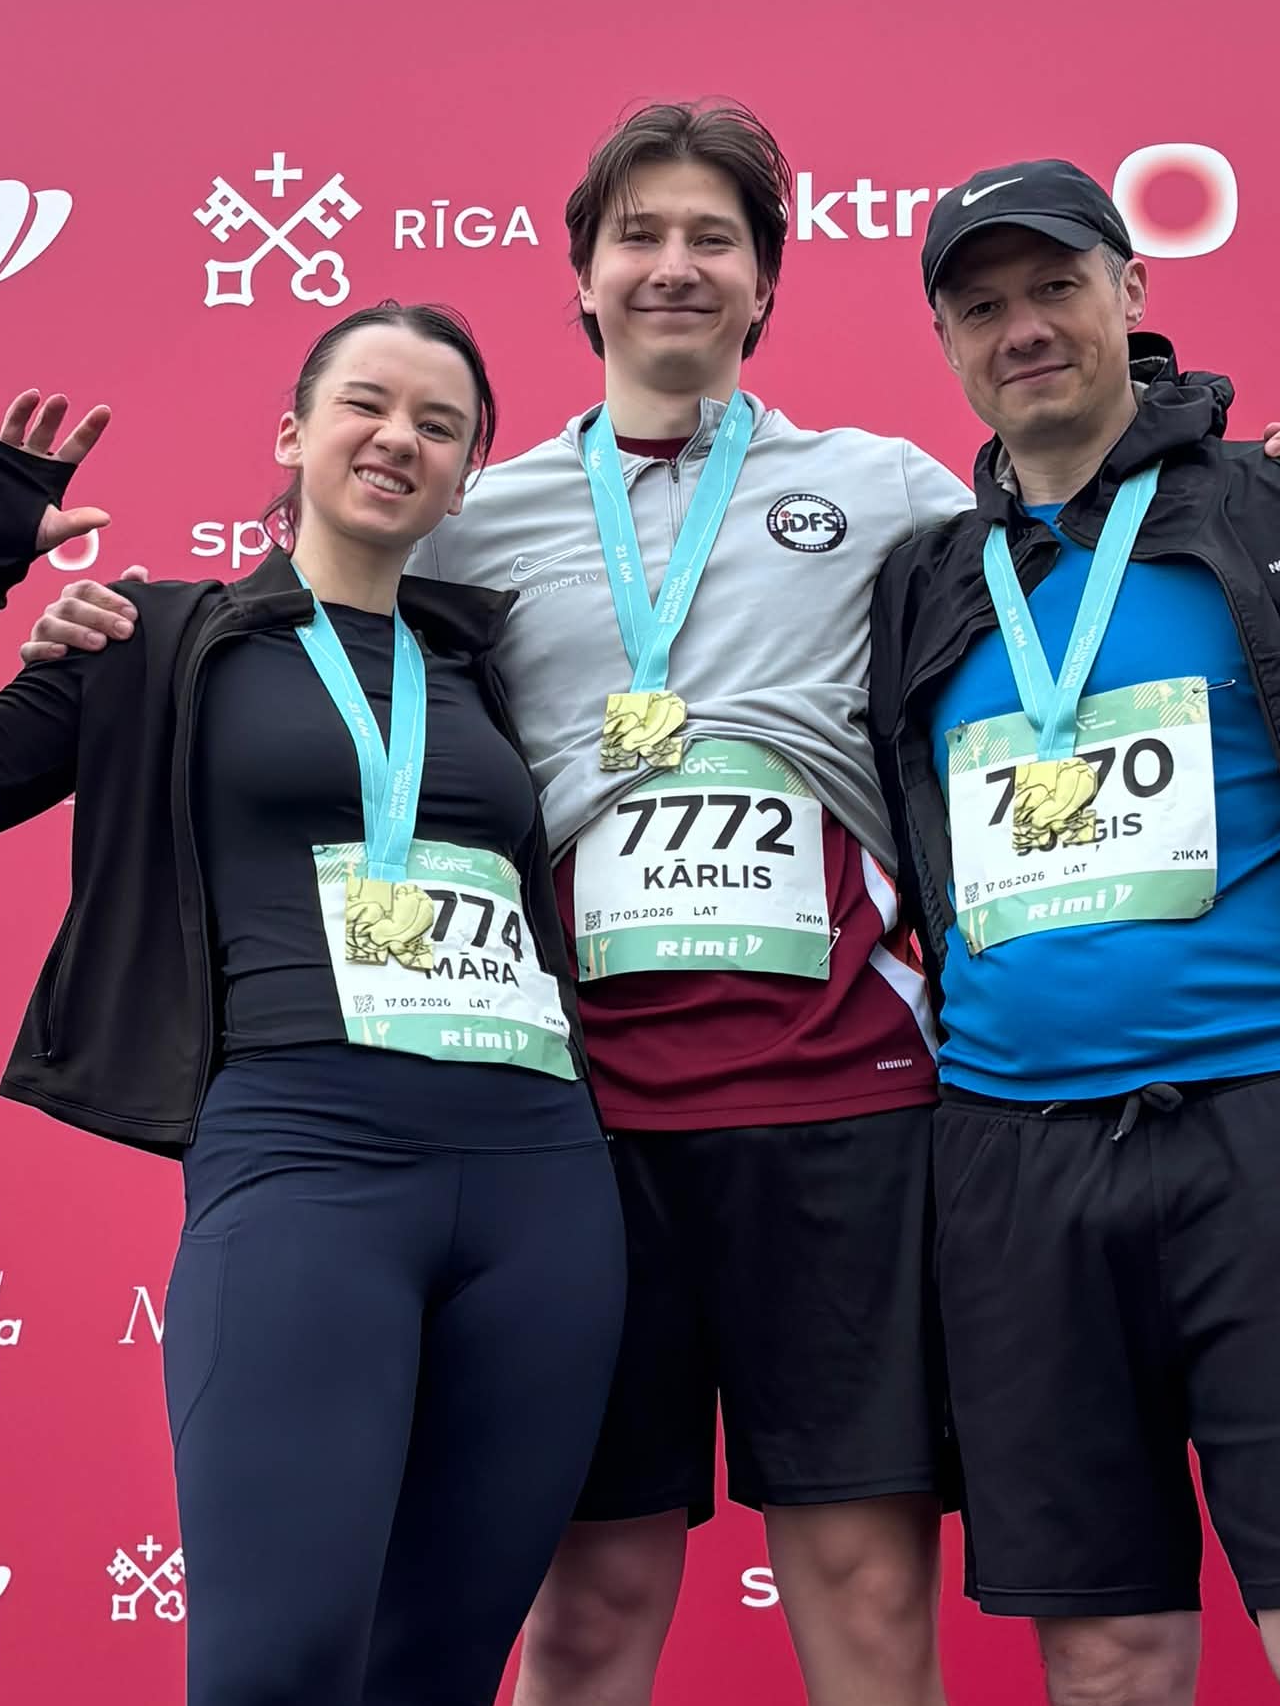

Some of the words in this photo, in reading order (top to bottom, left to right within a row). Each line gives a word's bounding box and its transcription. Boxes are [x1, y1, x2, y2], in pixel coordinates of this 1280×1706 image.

[395, 200, 538, 249] RĪGA
[986, 738, 1174, 826] 770
[617, 794, 795, 856] 7772
[1172, 850, 1209, 861] 21KM
[644, 859, 772, 890] KĀRLIS
[1063, 863, 1088, 876] LAT
[693, 906, 718, 917] LAT
[1027, 888, 1106, 921] Rimi
[423, 889, 524, 963] 774
[795, 913, 824, 926] 21KM
[656, 937, 739, 957] Rimi
[426, 951, 520, 988] MĀRA
[468, 998, 491, 1010] LAT
[440, 1027, 513, 1050] Rimi
